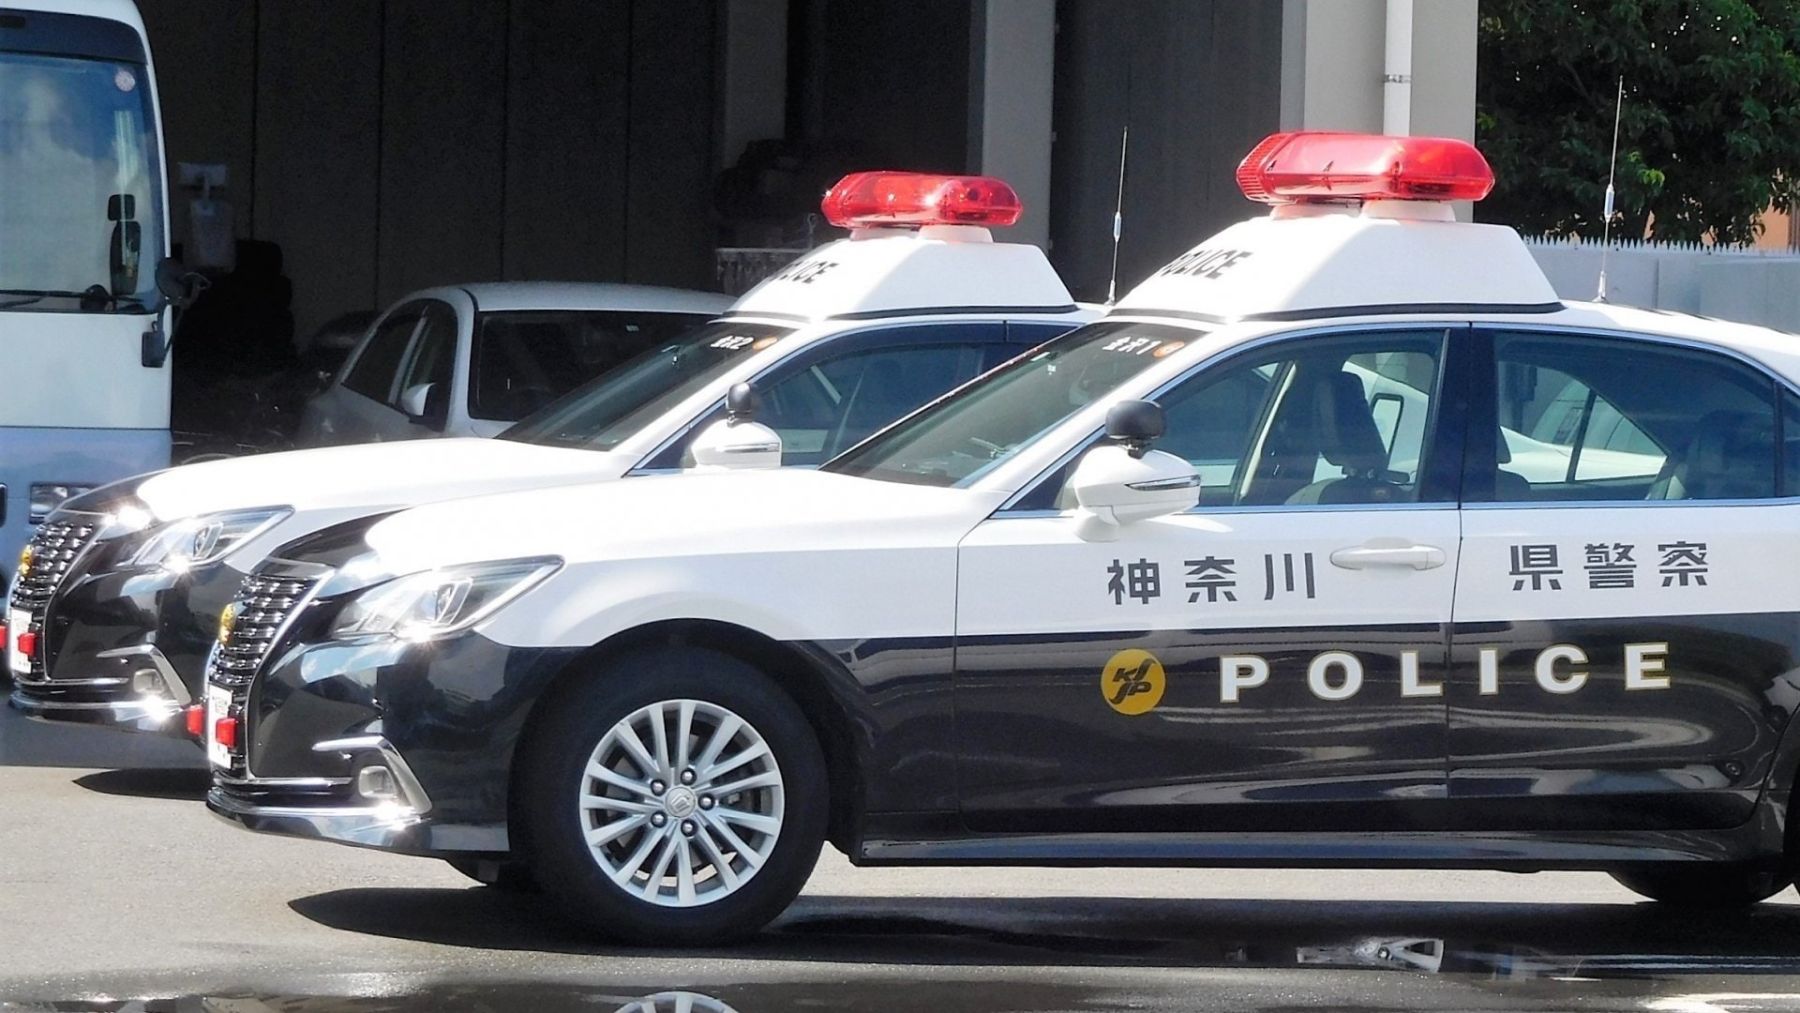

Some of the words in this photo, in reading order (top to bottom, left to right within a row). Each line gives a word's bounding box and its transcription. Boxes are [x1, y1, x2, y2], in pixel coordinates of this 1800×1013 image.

[1107, 553, 1316, 605] 神奈川
[1509, 541, 1708, 591] 県警察
[1219, 641, 1672, 703] POLICE
